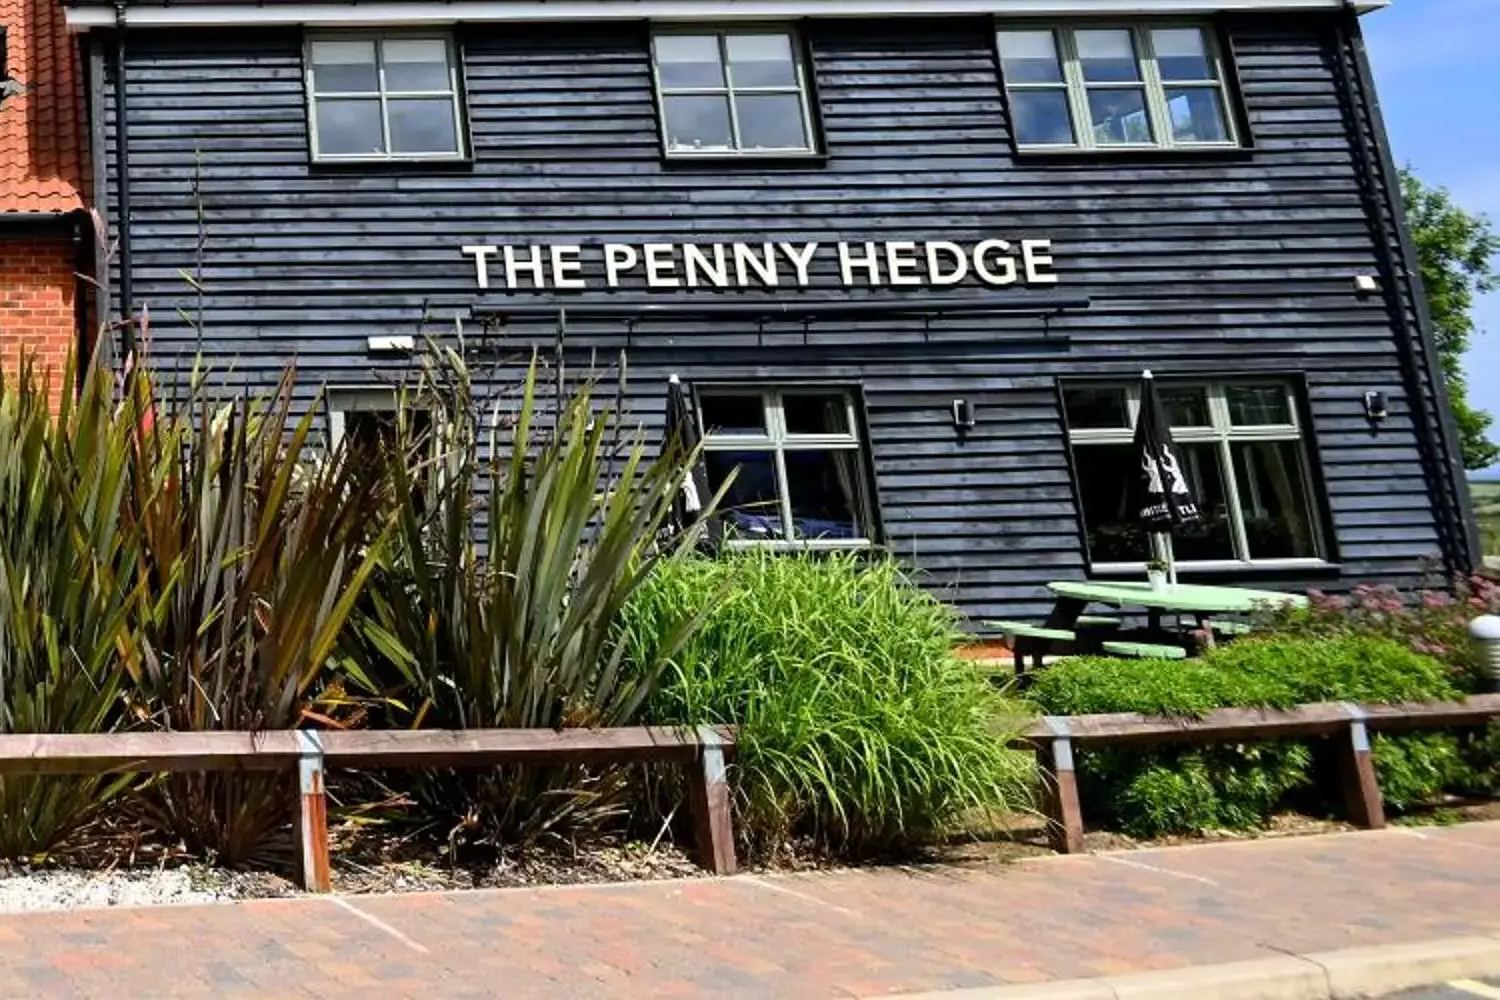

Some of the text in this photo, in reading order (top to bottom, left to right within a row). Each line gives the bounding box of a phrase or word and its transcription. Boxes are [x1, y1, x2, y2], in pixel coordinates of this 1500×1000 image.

[461, 239, 1058, 288] THE PENNY HEDGE
